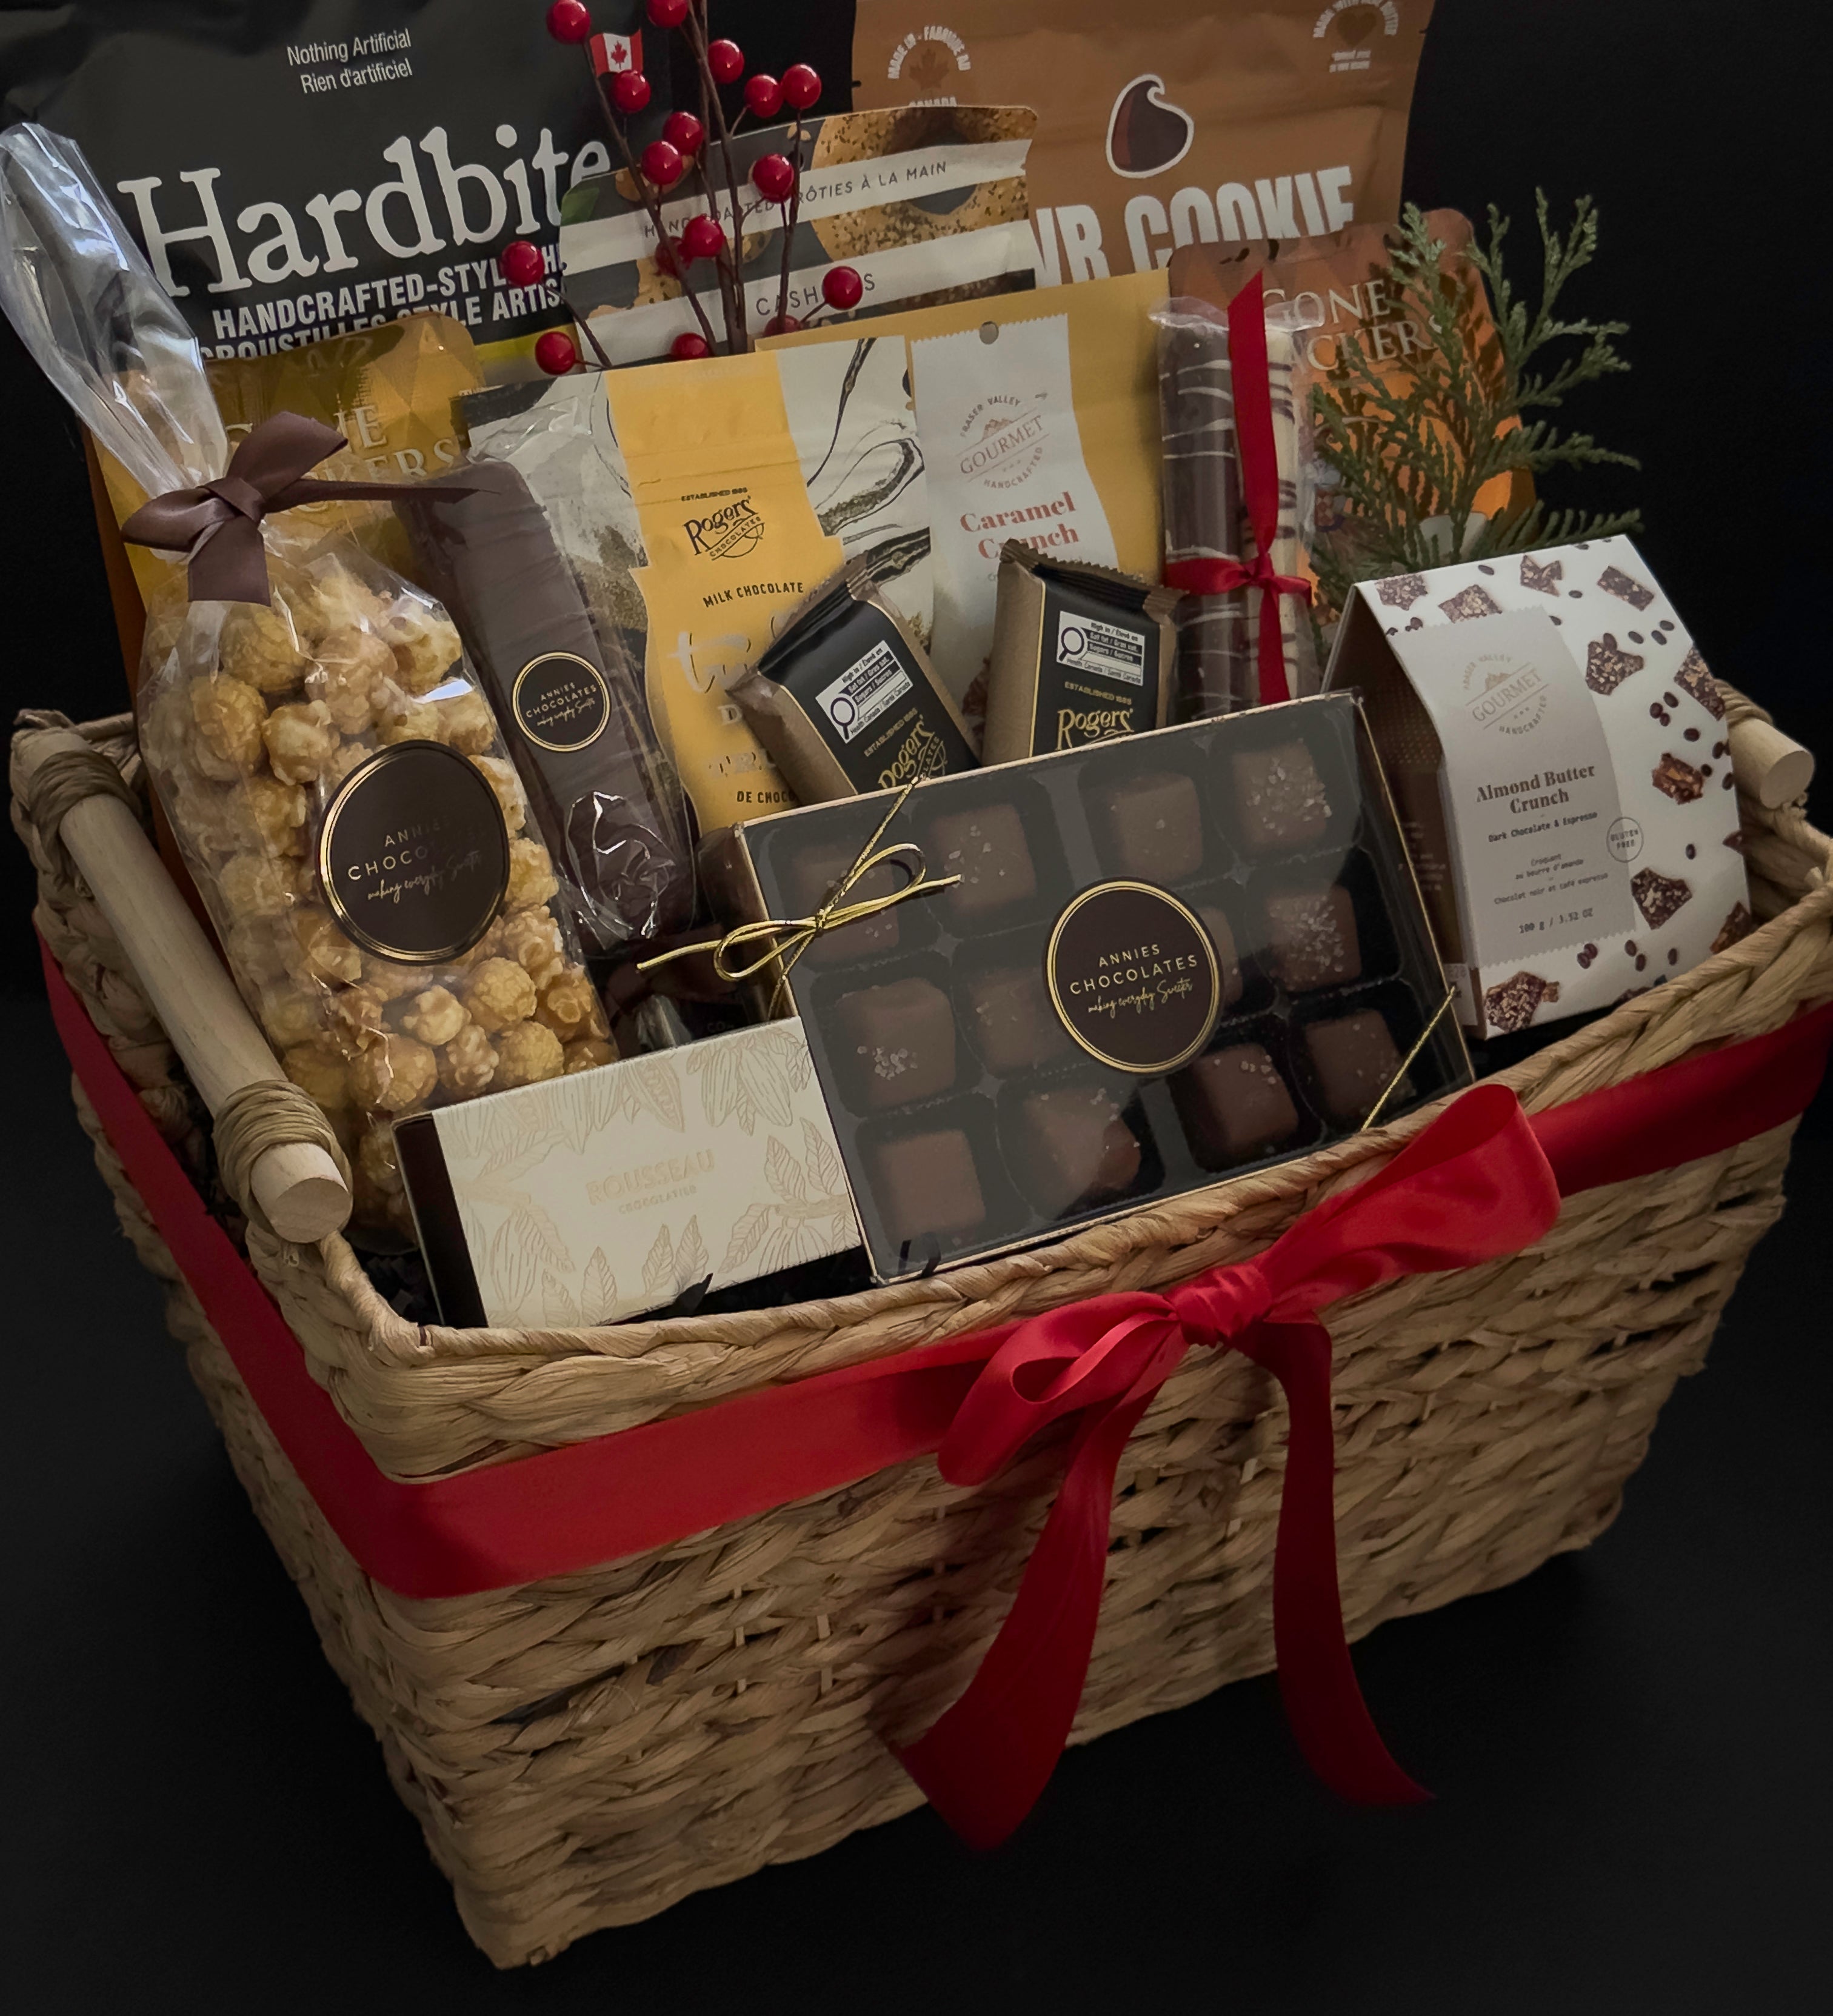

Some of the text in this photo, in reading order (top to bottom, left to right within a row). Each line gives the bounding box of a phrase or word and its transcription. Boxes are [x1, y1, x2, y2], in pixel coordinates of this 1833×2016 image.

[287, 27, 412, 66] Nothing Artificial
[887, 44, 908, 79] MADE
[300, 57, 413, 94] Rien d'artificiel
[798, 181, 853, 204] RÔTIES
[861, 174, 871, 190] À
[879, 172, 898, 187] LA
[906, 161, 946, 181] MAIN
[212, 258, 507, 339] HANDCRAFTED-STYL
[492, 278, 561, 321] ARTIS
[756, 273, 875, 316] CSHS
[987, 395, 1021, 407] VALLEY
[960, 415, 1043, 475] GOURMET
[960, 491, 1077, 533] Caramel
[978, 523, 1080, 559] Cnch
[703, 582, 804, 608] MILK CHOCOLATE
[526, 684, 597, 718] CHOCOLATES
[540, 682, 576, 701] ANNIES
[1472, 667, 1543, 722] GOURMET
[736, 790, 752, 803] DE
[1477, 766, 1596, 803] Almond Butter
[1509, 788, 1570, 814] Crunch
[1488, 832, 1507, 843] Dark
[1511, 822, 1551, 838] Chocolate
[1098, 943, 1160, 967] ANNIES
[1070, 954, 1198, 995] CHOCOLATES
